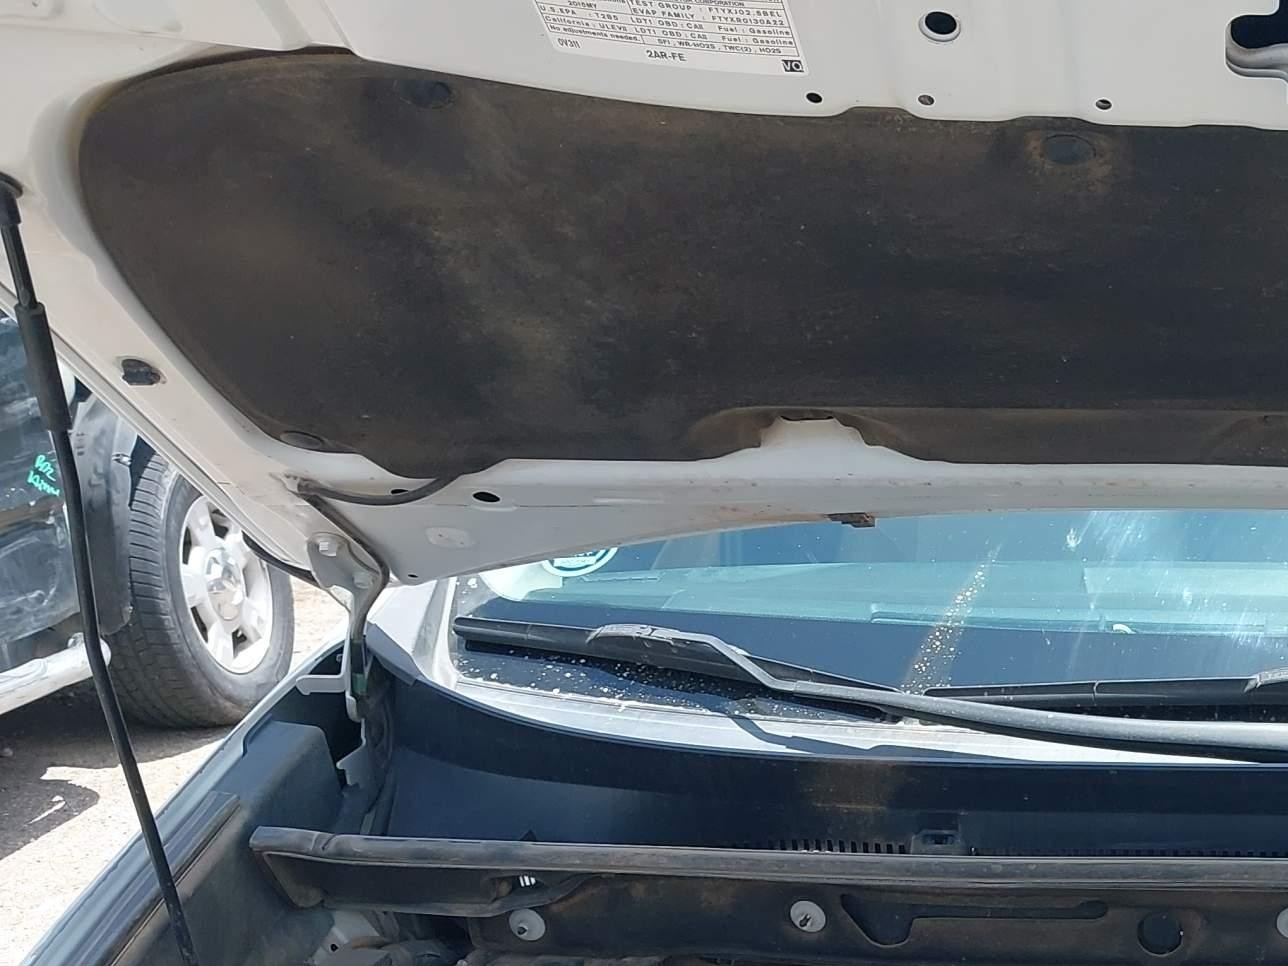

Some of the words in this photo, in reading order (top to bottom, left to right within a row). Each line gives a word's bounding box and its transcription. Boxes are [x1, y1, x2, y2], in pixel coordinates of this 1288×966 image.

[658, 1, 692, 11] GROUP
[632, 7, 657, 16] EVAP
[661, 11, 695, 20] FAMILY
[544, 16, 590, 27] California
[662, 30, 682, 38] OBD
[722, 35, 742, 43] Fuel
[752, 37, 794, 46] Gasoline
[549, 24, 561, 32] No
[563, 26, 609, 38] adjustments
[658, 20, 678, 28] OBD
[718, 25, 738, 33] Fuel
[749, 27, 791, 36] Gasoline
[646, 49, 687, 62] 2AR-FE
